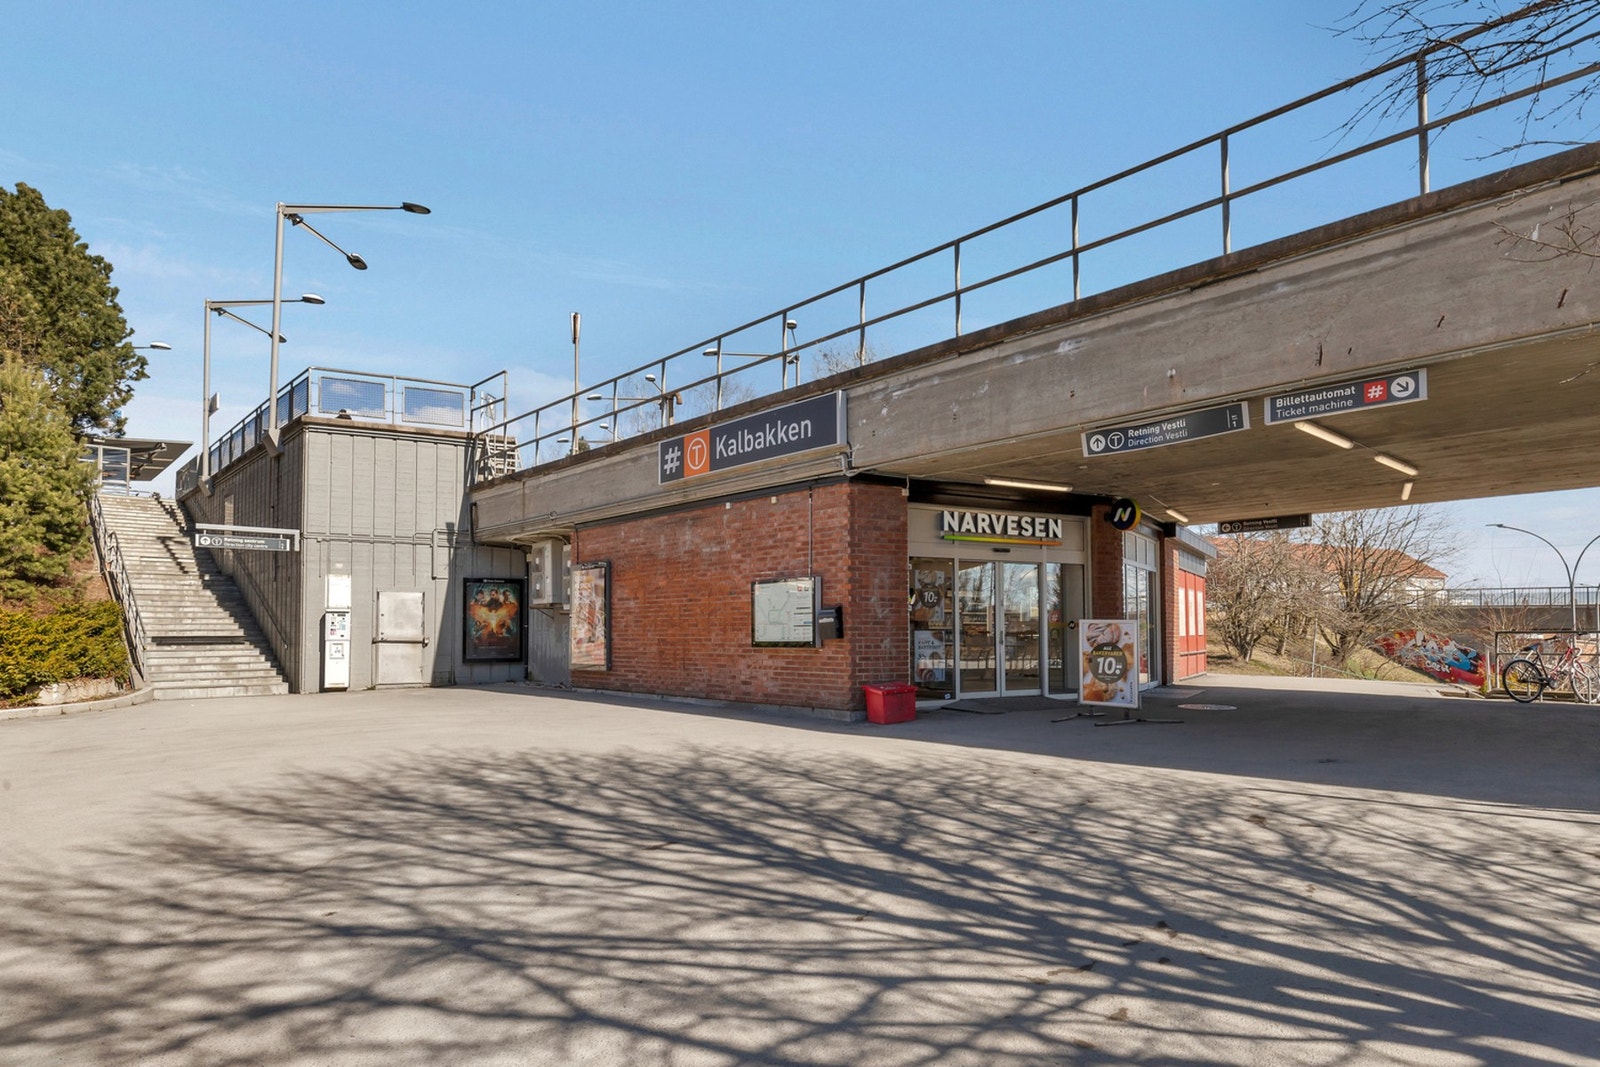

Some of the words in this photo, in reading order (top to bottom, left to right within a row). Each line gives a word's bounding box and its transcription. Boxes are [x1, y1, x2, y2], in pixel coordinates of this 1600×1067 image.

[1276, 386, 1356, 408] Billettautomat
[1276, 406, 1306, 419] Ticket
[1309, 398, 1354, 413] machine
[716, 418, 812, 459] Kalbakken
[1128, 425, 1160, 438] Retning
[1162, 418, 1186, 431] Vestli
[1128, 435, 1164, 447] Direction
[1165, 429, 1188, 441] Vestli
[943, 510, 1063, 538] NARVESEN
